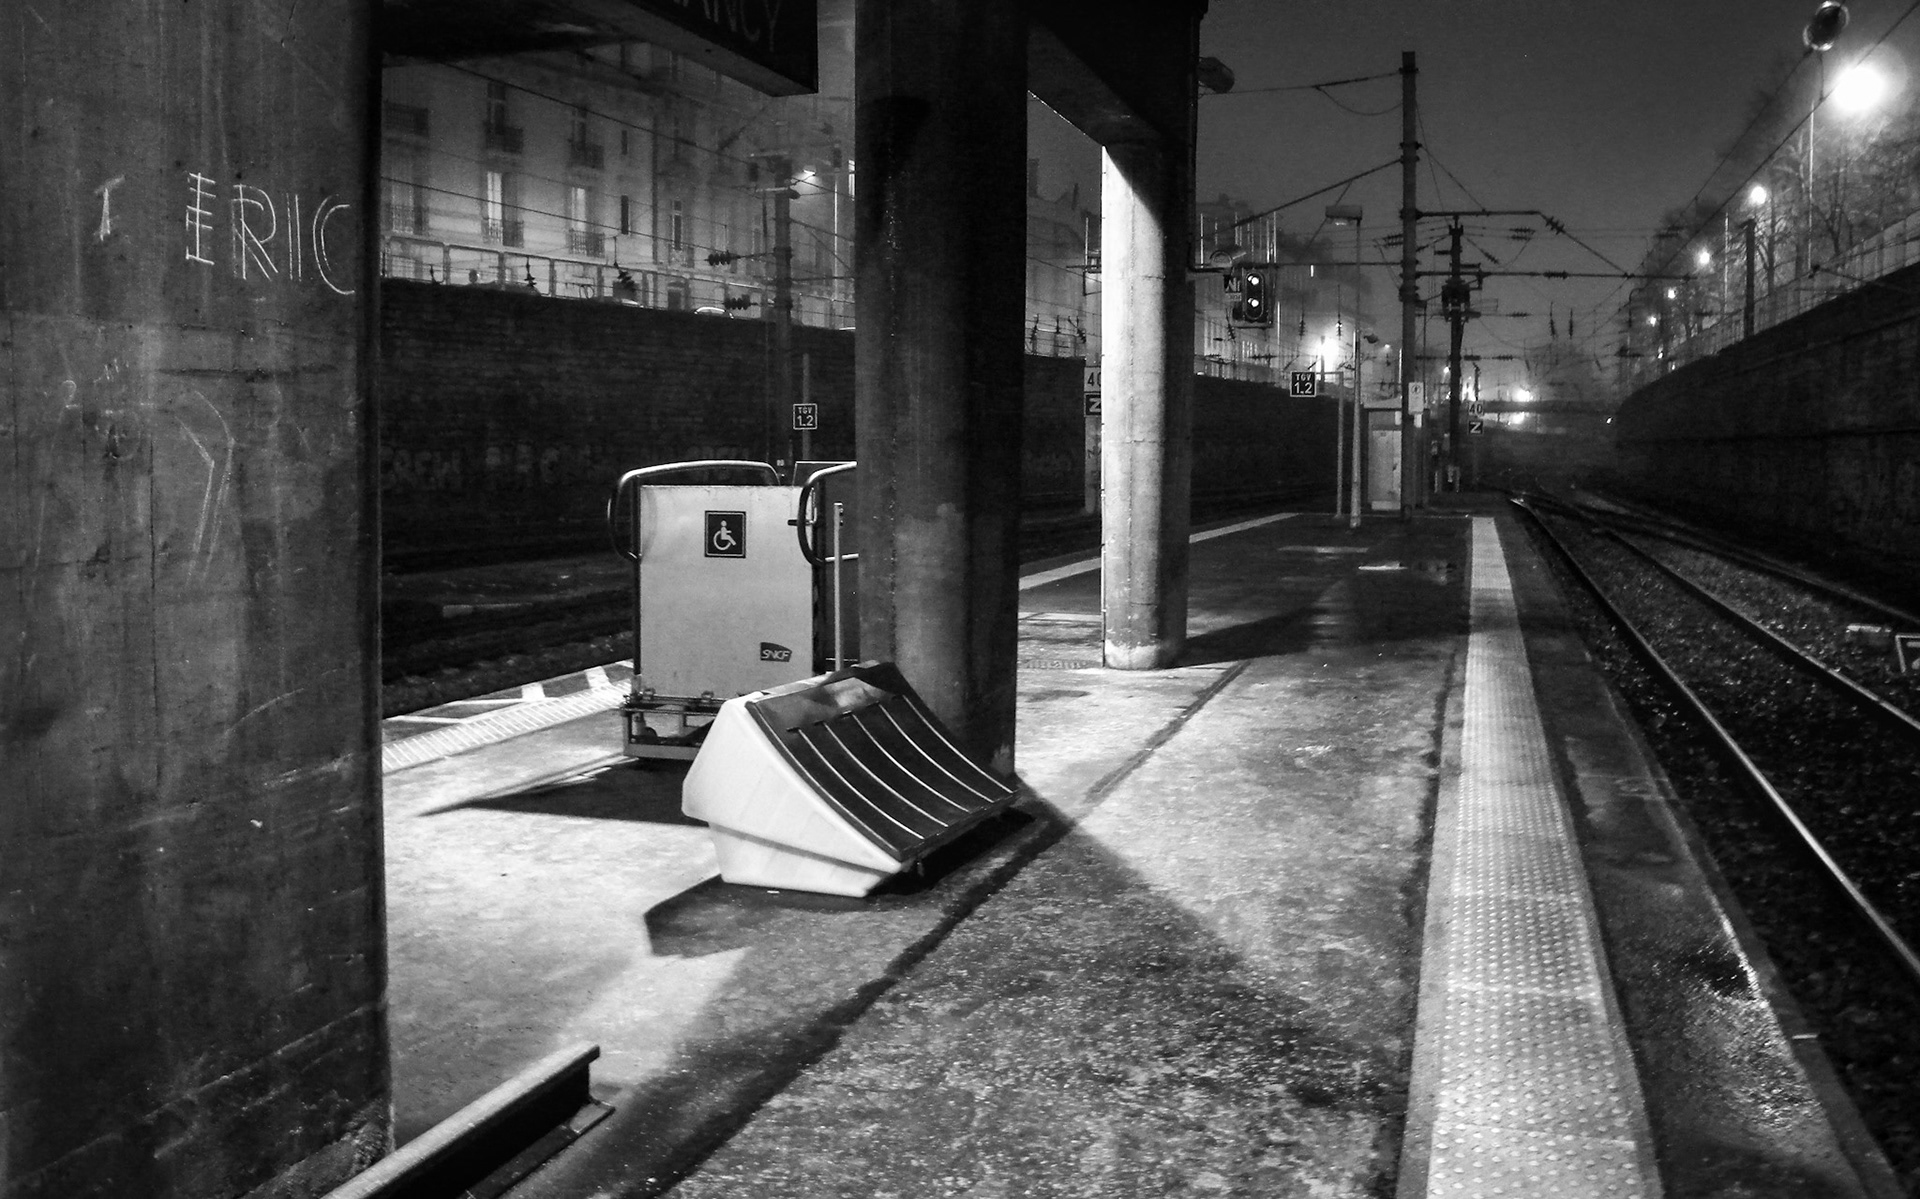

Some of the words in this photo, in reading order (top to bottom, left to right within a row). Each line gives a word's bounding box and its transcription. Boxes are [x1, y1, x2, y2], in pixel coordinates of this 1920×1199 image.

[1294, 381, 1313, 394] 1.2
[797, 406, 813, 414] TGV
[1468, 403, 1483, 415] 40
[796, 415, 814, 426] 1.2
[1470, 421, 1481, 434] Z
[761, 649, 790, 660] SNCF
